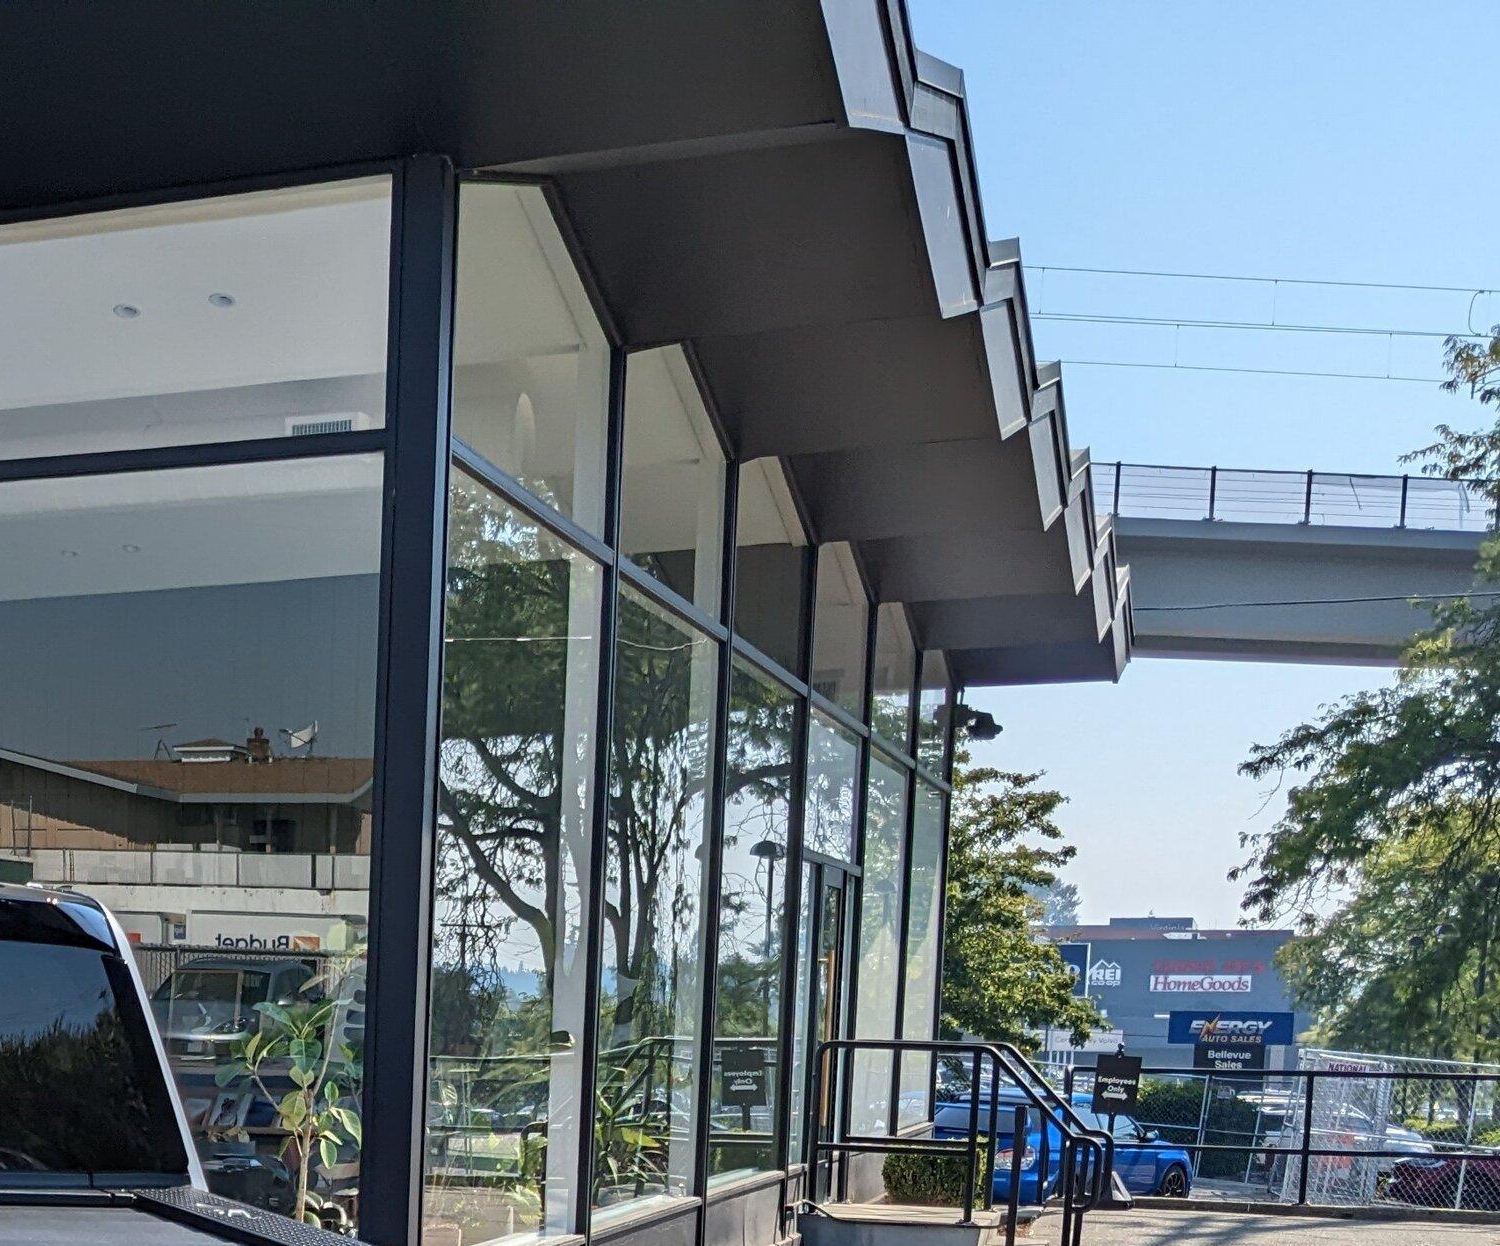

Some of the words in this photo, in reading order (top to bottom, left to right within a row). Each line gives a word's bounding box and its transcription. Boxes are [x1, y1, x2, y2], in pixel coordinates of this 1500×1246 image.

[1091, 968, 1121, 980] REI
[1152, 976, 1250, 991] HomeGoods
[1189, 1020, 1273, 1034] ENERGY
[1207, 1050, 1252, 1060] Bellevue
[1215, 1060, 1242, 1069] Sales
[1098, 1076, 1136, 1085] Employees
[1107, 1085, 1124, 1093] Only
